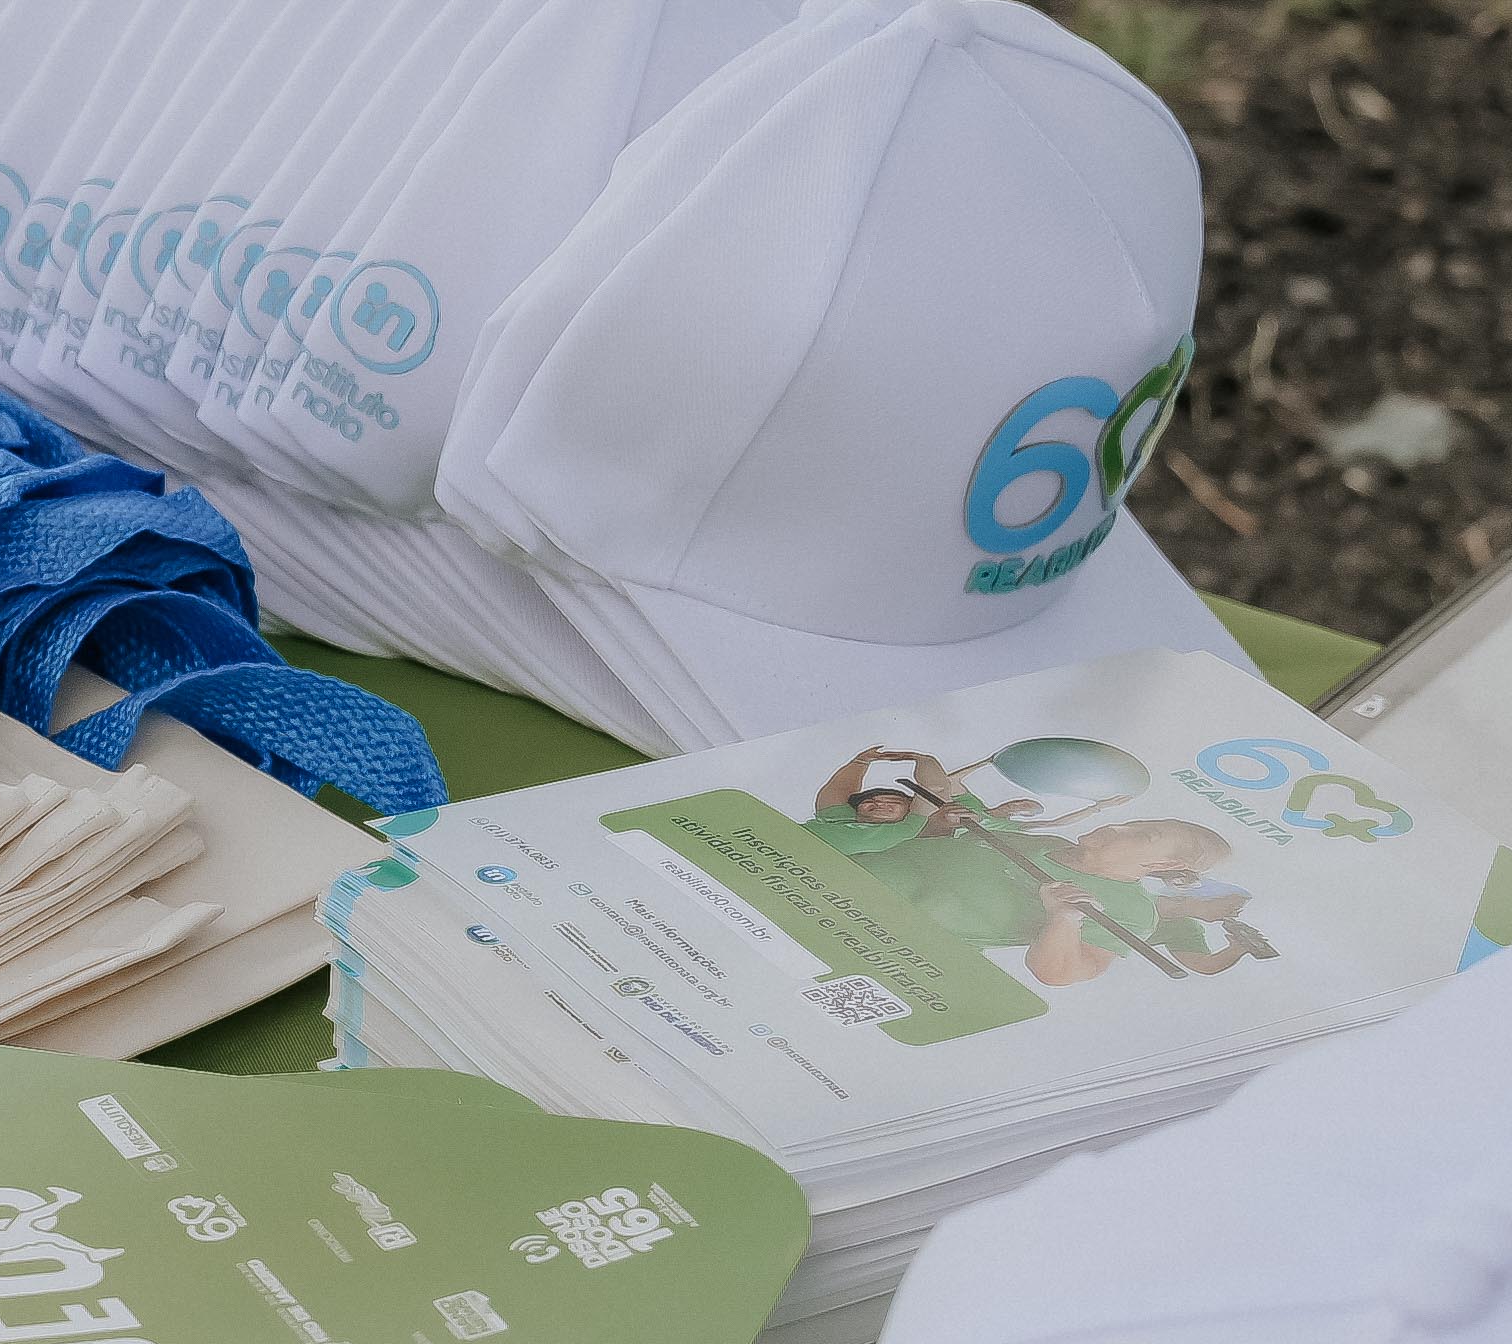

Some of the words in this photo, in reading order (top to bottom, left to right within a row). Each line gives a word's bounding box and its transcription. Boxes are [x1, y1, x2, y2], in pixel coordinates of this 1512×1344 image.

[1169, 767, 1294, 847] REABILITA
[659, 859, 773, 943] reabilita60.com.br
[669, 815, 764, 876] atividades
[818, 917, 836, 929] e
[833, 927, 949, 1013] reabilitação
[731, 826, 825, 892] Inscrições
[822, 890, 898, 947] abertas
[887, 945, 944, 978] para
[589, 896, 734, 1009] contato@institutonata.org.br
[625, 898, 656, 921] Mais
[651, 918, 727, 980] informações:
[639, 996, 663, 1013] RIO
[658, 1010, 680, 1025] DE
[674, 1018, 725, 1056] JANEIRO
[767, 1036, 849, 1099] @institutonata
[97, 1097, 154, 1152] MESQUITA
[534, 1206, 609, 1270] DISQUE
[559, 1200, 635, 1262] IDOSO
[583, 1186, 675, 1252] 165
